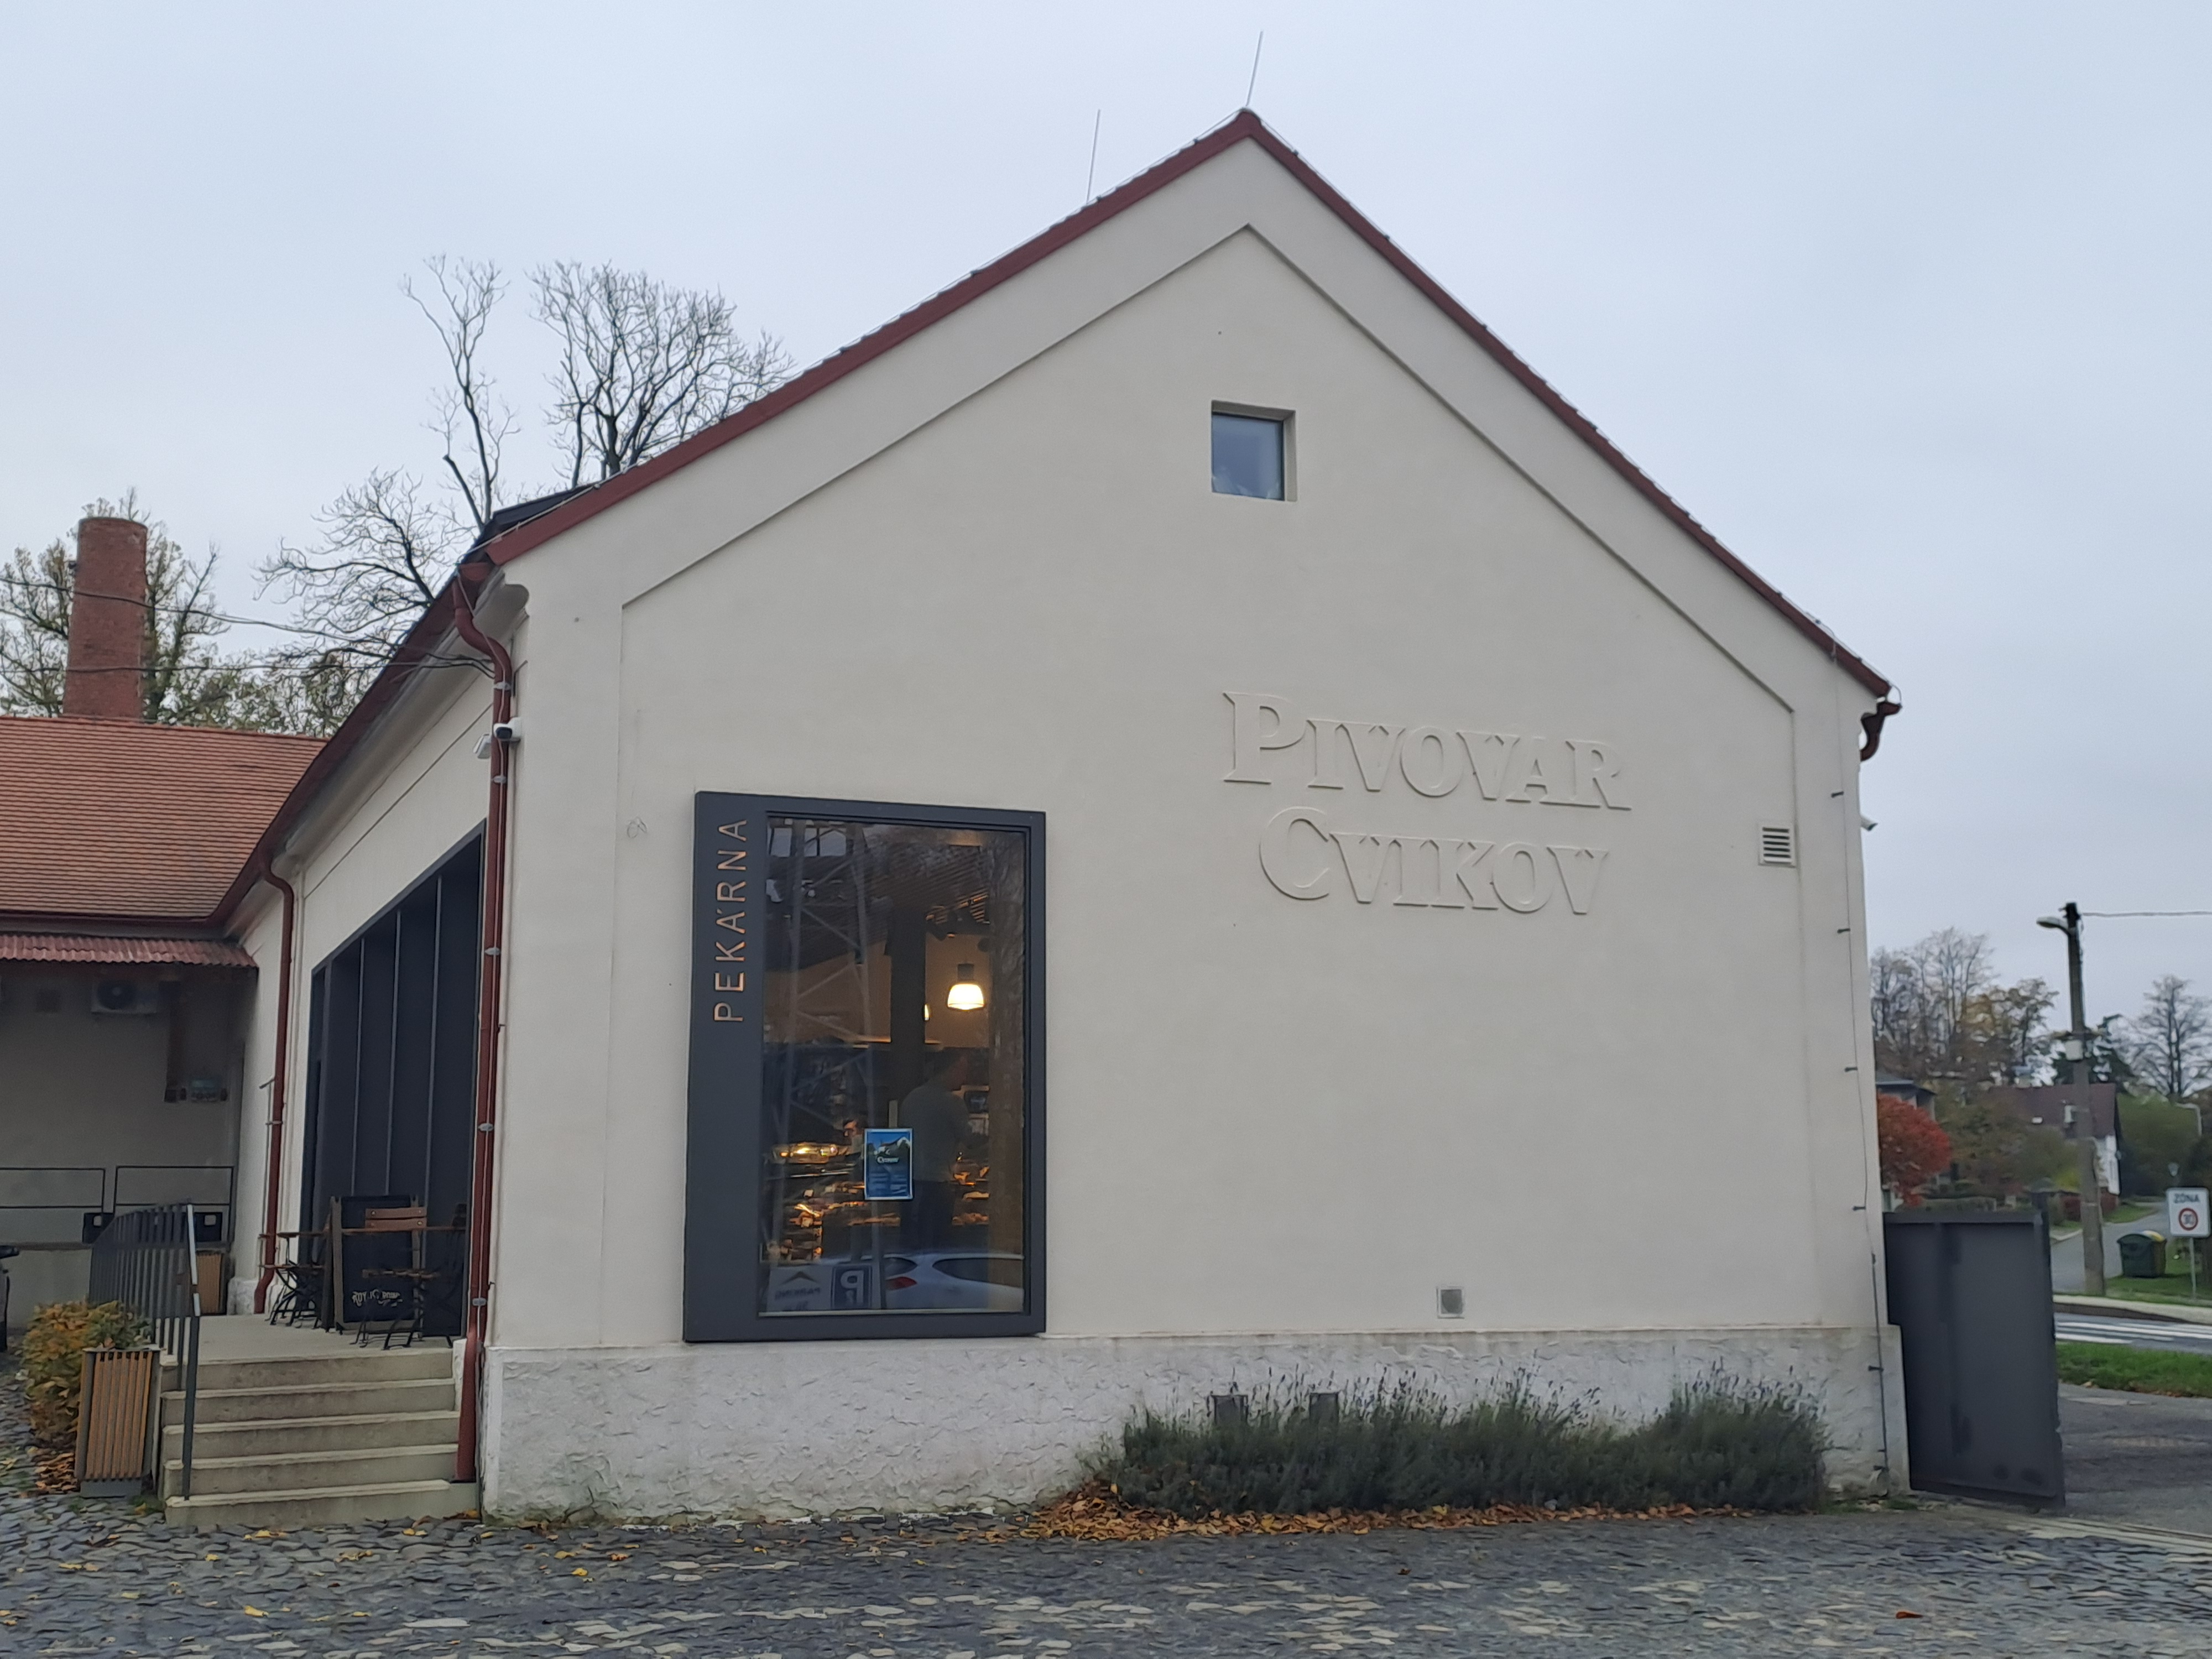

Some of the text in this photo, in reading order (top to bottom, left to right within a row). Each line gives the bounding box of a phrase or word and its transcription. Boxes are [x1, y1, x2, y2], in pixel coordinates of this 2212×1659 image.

[1222, 691, 1632, 811] PIVOVAR
[713, 820, 748, 1022] PEKÁRNA
[1259, 806, 1609, 916] CVIKOV
